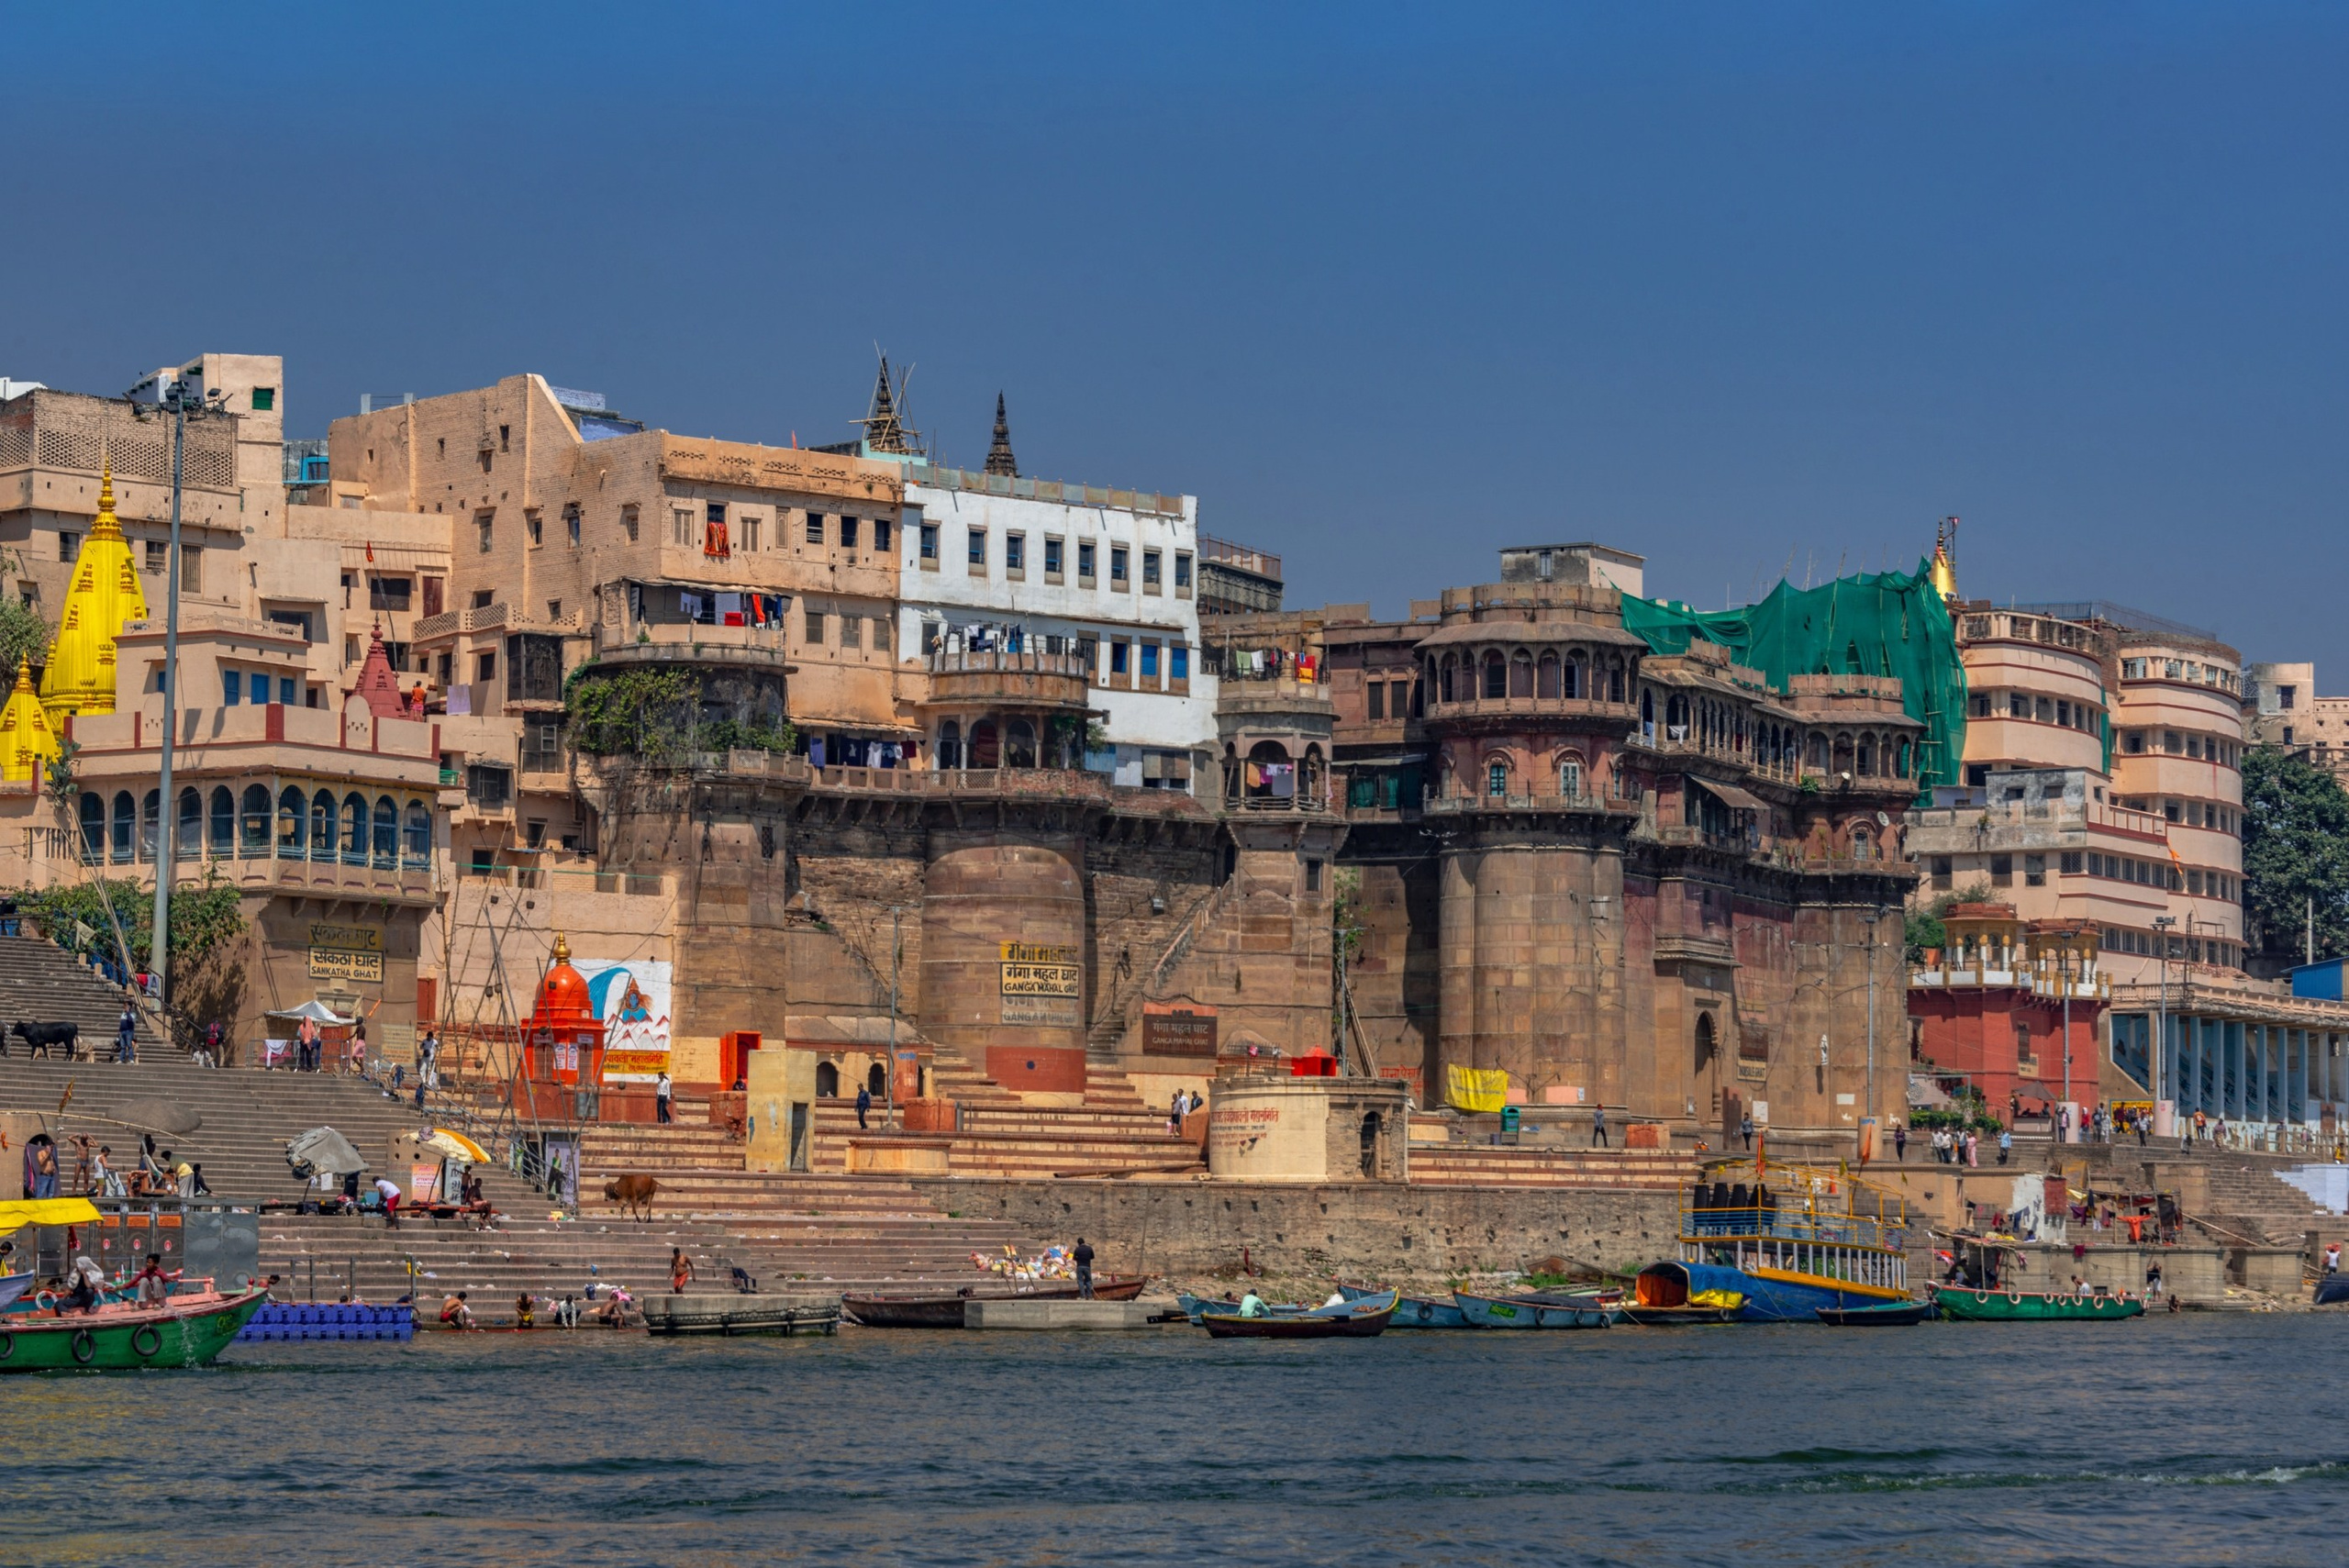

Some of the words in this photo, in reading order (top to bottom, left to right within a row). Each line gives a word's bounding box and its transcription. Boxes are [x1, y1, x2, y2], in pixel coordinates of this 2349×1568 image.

[313, 948, 351, 965] संकठा
[353, 953, 380, 968] घाट
[311, 965, 351, 977] SANKATHA
[353, 969, 379, 979] GHAT
[1006, 964, 1030, 979] गंगा
[1032, 967, 1059, 982] महल
[1061, 968, 1077, 982] घाट
[1004, 983, 1036, 992] GANGA
[1037, 983, 1063, 994] MAHAL
[1152, 1019, 1169, 1033] गंगा
[1171, 1023, 1192, 1035] महल
[1193, 1024, 1208, 1034] घाट
[1152, 1036, 1173, 1044] GANGA
